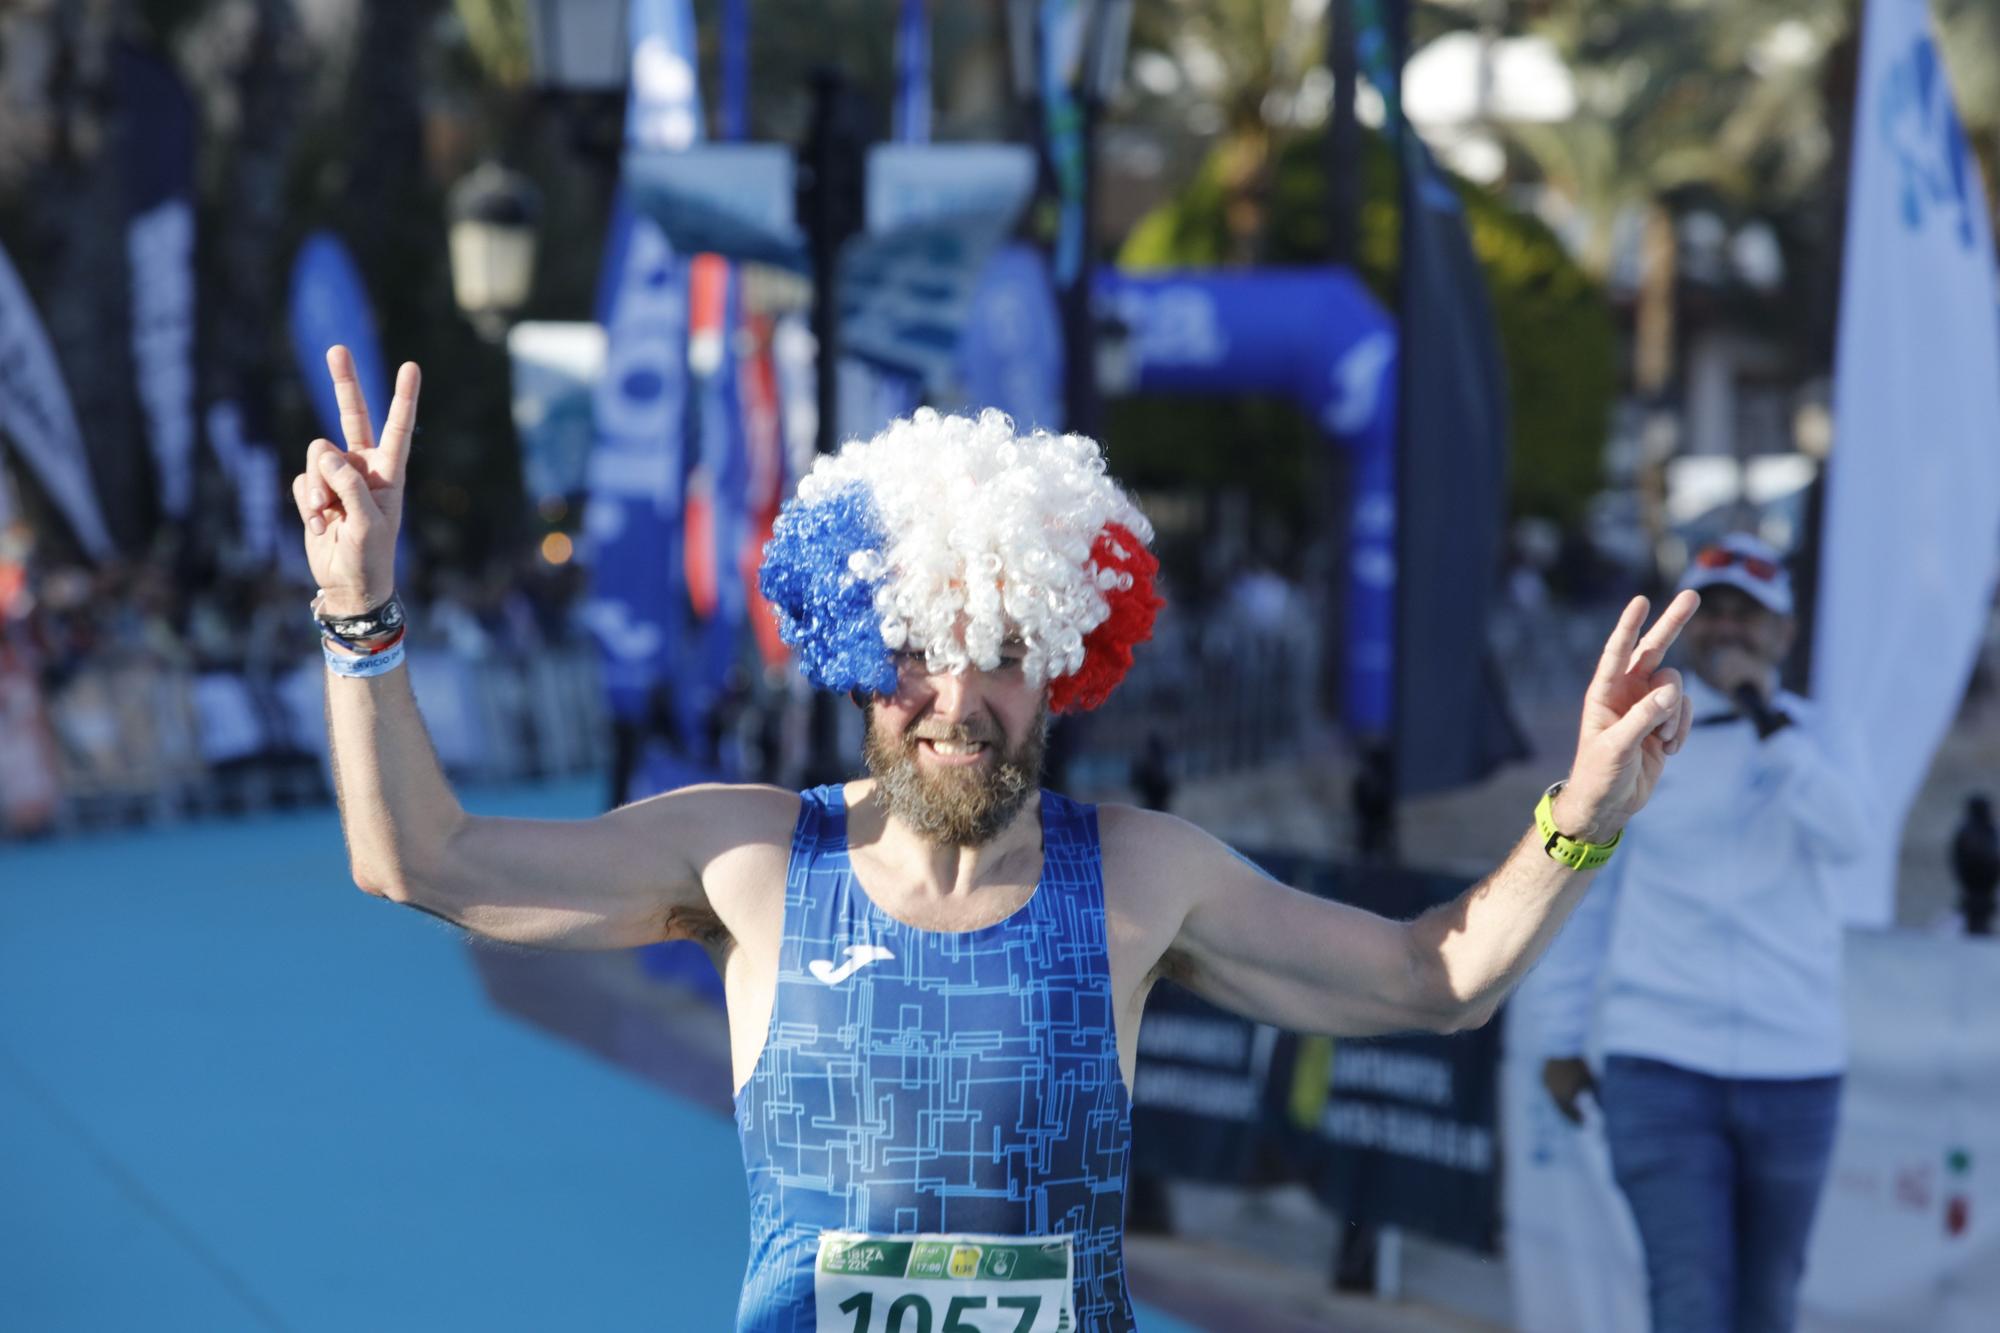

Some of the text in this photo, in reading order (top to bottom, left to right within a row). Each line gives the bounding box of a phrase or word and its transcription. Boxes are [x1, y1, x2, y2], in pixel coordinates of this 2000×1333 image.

[346, 656, 389, 670] SERVICIO
[847, 1247, 885, 1262] IBIZA
[847, 1260, 870, 1272] 22K
[916, 1262, 942, 1273] 17:00
[838, 1291, 1042, 1333] 1057
